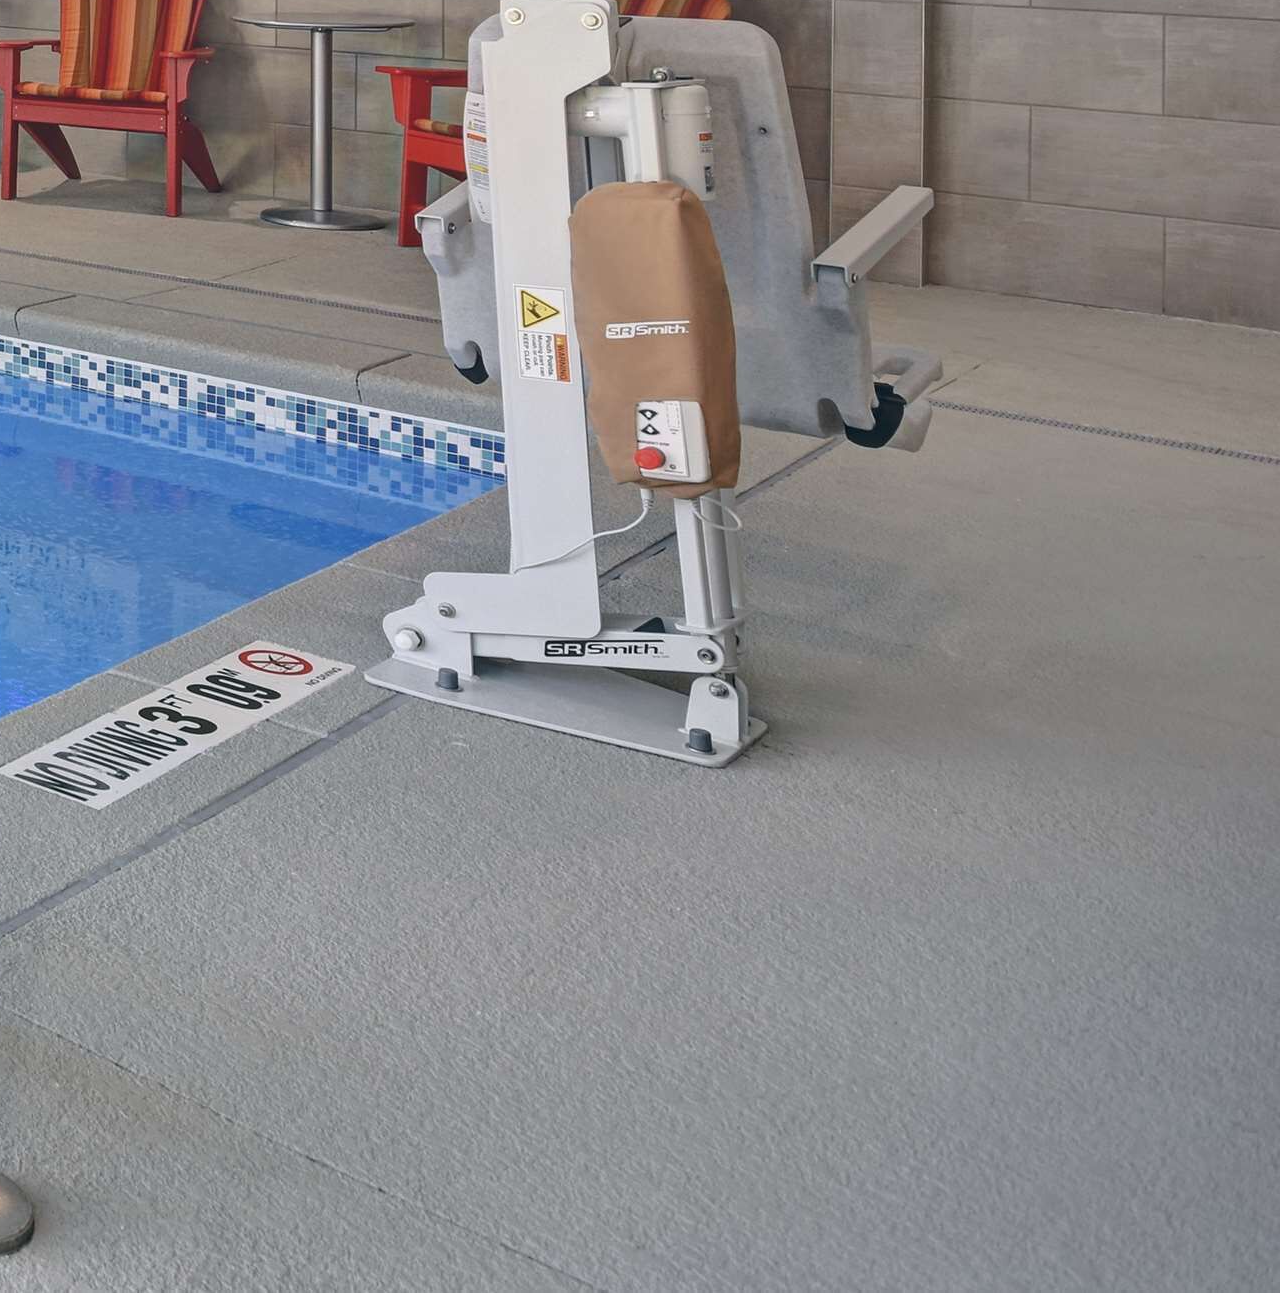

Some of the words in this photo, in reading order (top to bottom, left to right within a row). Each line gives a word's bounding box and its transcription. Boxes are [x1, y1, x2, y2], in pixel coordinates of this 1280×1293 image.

[557, 345, 567, 381] WARNING
[217, 668, 240, 679] M
[304, 678, 320, 686] NO
[316, 667, 342, 681] DIVING
[158, 694, 193, 709] FT
[138, 706, 217, 735] 3
[53, 720, 188, 780] DIVING
[14, 762, 110, 801] NO
